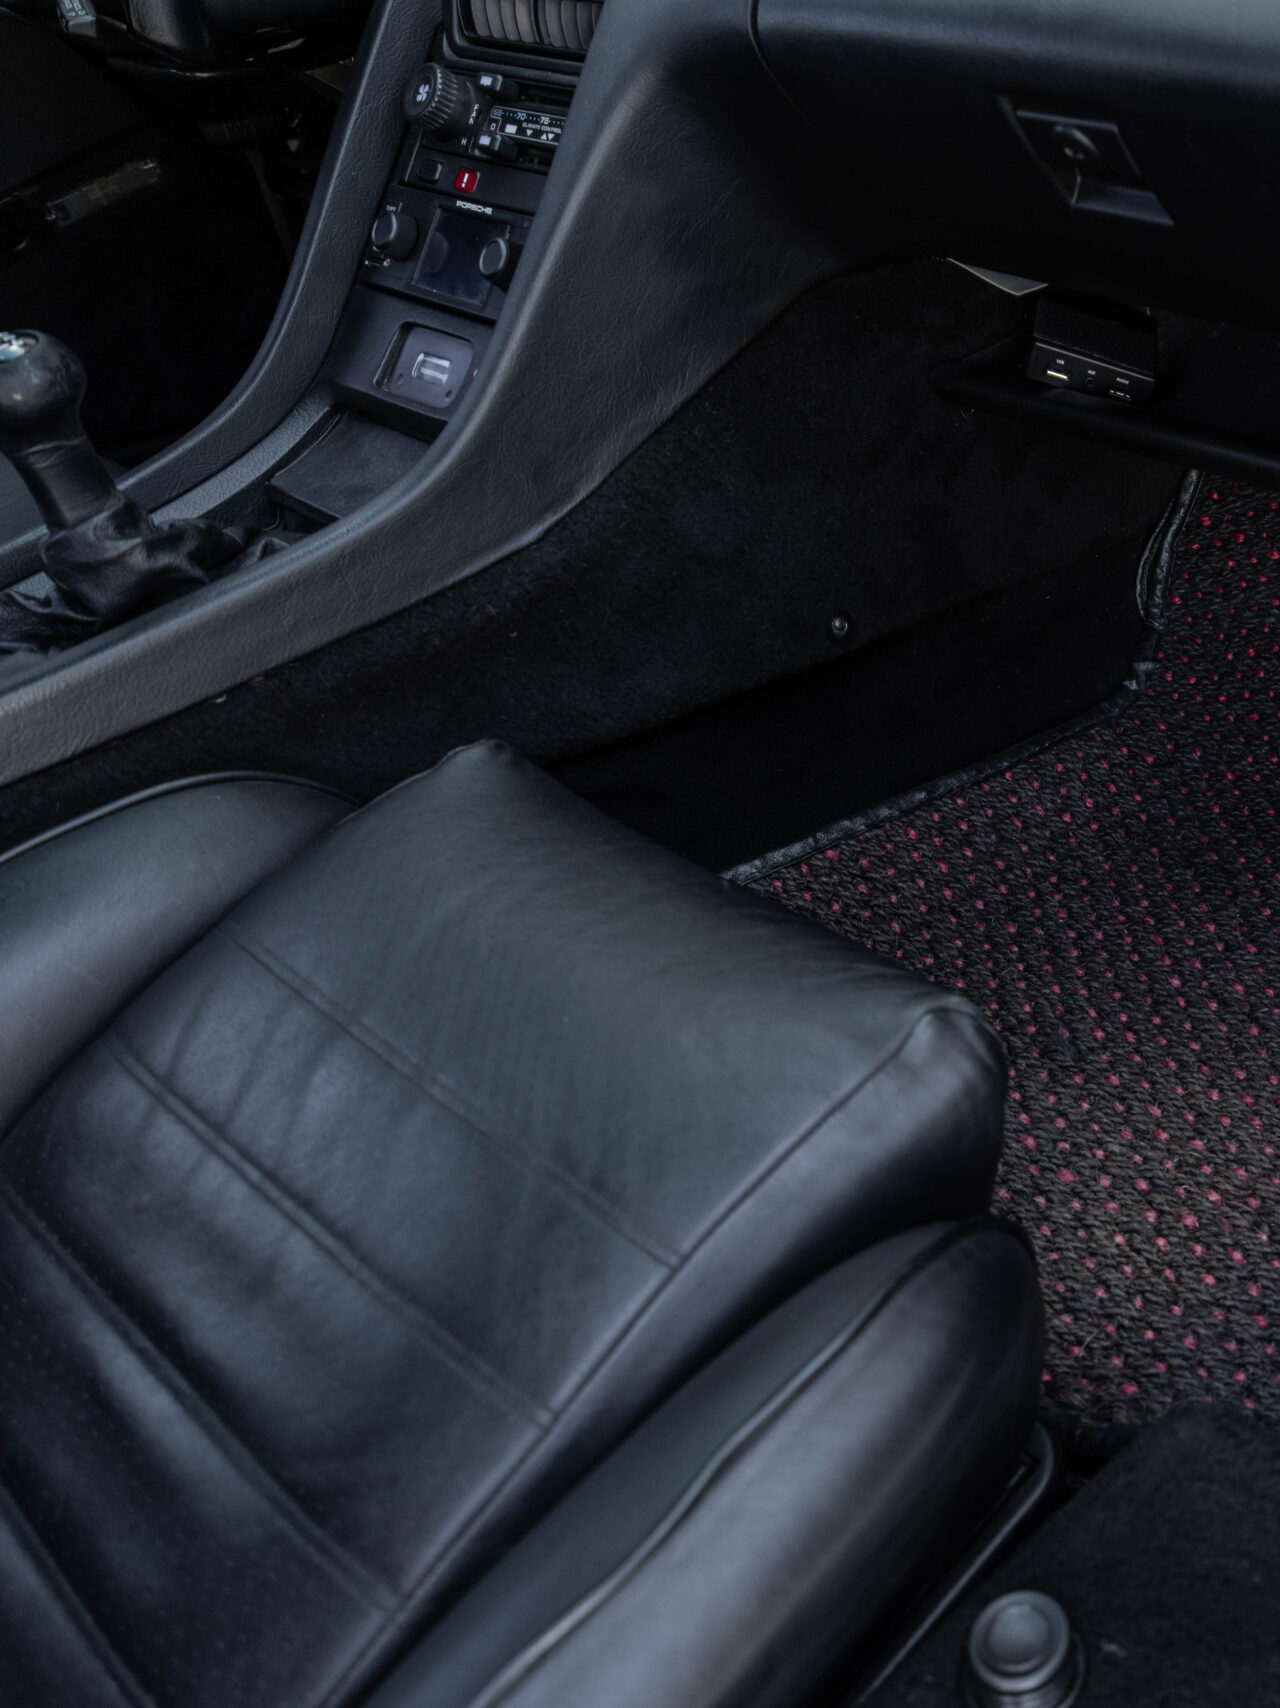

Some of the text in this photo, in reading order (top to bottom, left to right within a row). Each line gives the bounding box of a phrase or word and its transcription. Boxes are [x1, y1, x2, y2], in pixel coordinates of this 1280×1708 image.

[516, 112, 526, 120] 70
[540, 116, 549, 124] 75
[522, 122, 562, 134] CLIMATE CONTROL
[456, 200, 493, 215] PORSCHE
